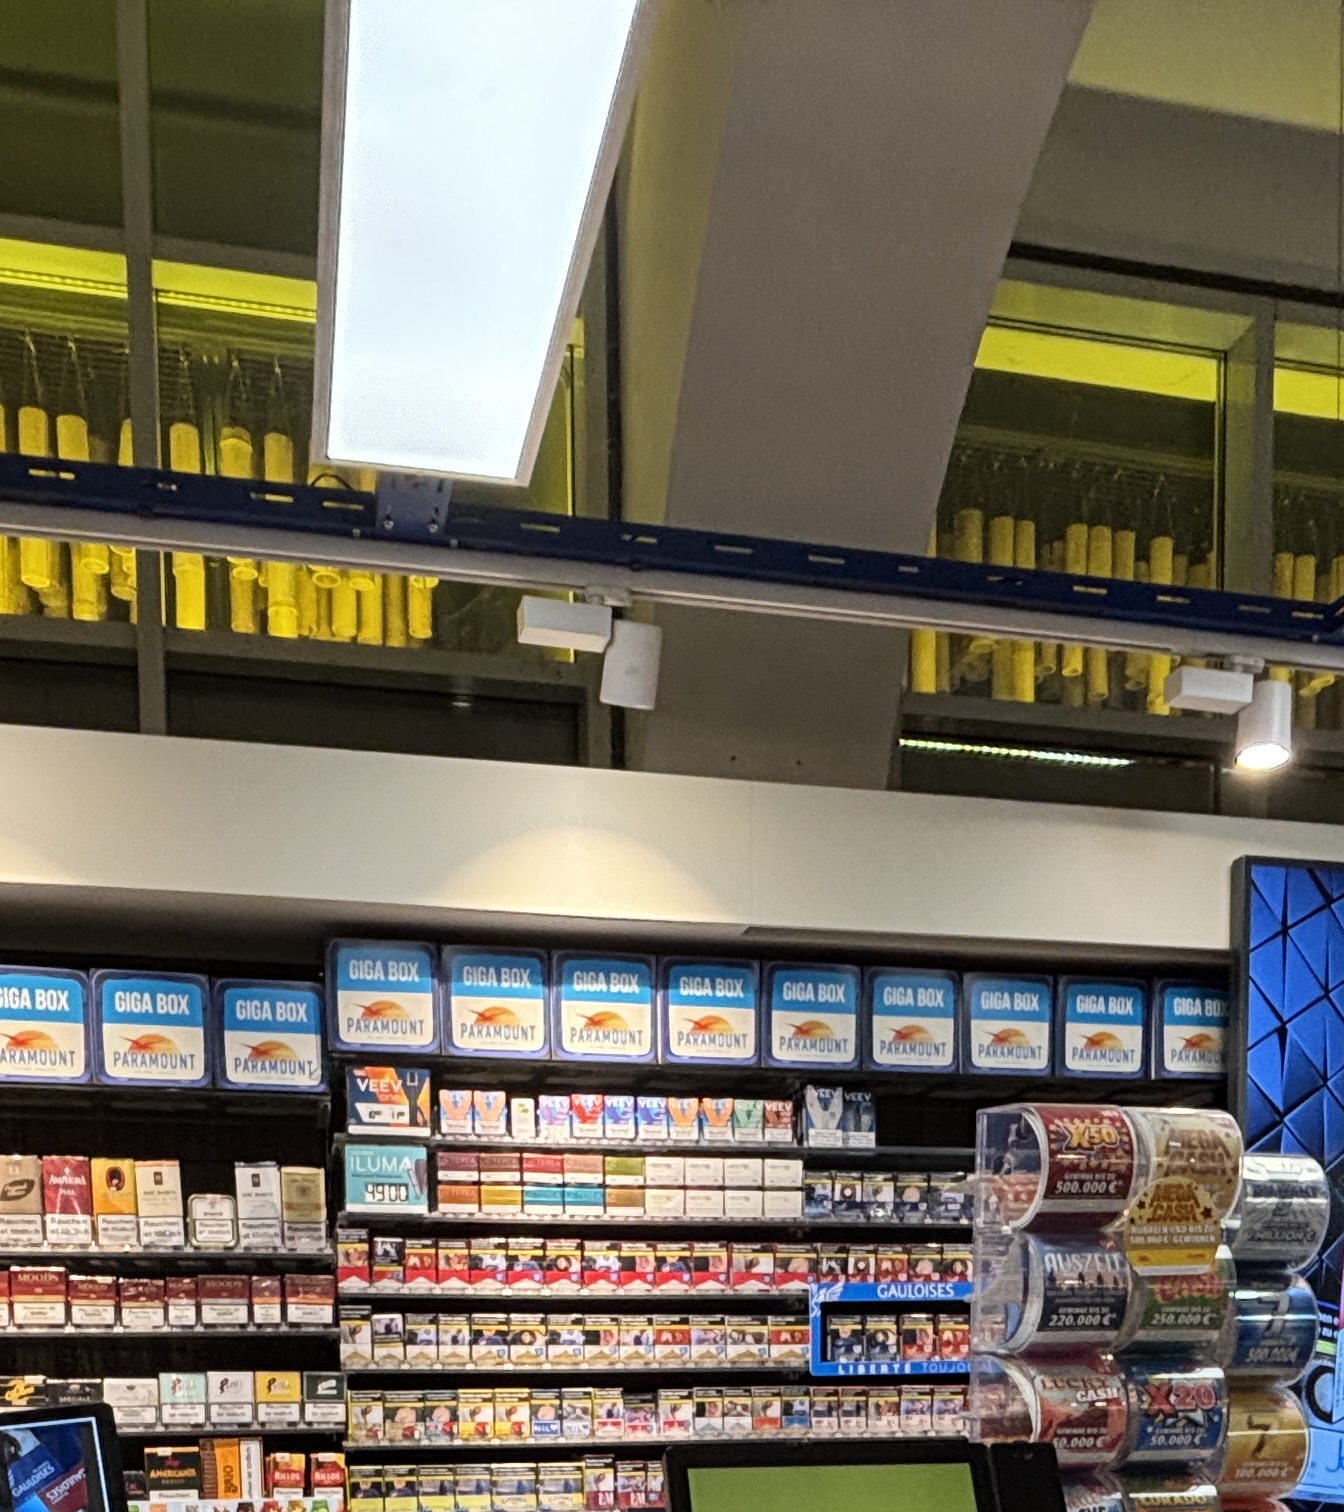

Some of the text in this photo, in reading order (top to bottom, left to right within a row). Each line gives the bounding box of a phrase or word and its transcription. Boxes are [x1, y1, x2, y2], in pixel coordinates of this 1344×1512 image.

[348, 960, 420, 983] GIGA BOX
[462, 965, 532, 990] GIGA BOX
[572, 970, 640, 994] GIGA BOX
[679, 976, 745, 999] GIGA BOX
[34, 989, 70, 1012] BOX
[782, 981, 846, 1004] GIGA BOX
[883, 986, 944, 1008] GIGA BOX
[980, 991, 1041, 1013] GIGA BOX
[114, 992, 190, 1016] GIGA BOX
[235, 999, 308, 1023] GIGA BOX
[1076, 995, 1134, 1016] GIGA BOX
[1173, 998, 1201, 1017] GIGA
[346, 1016, 425, 1036] PARAMOUNT
[460, 1022, 536, 1042] PARAMOUNT
[569, 1027, 644, 1047] PARAMOUNT
[676, 1031, 748, 1050] PARAMOUNT
[779, 1035, 849, 1054] PARAMOUNT
[879, 1040, 947, 1058] PARAMOUNT
[978, 1044, 1043, 1062] PARAMOUNT
[1071, 1046, 1135, 1064] PARAMOUNT
[113, 1050, 196, 1070] PARAMOUNT
[233, 1058, 315, 1077] PARAMOUNT
[356, 1077, 403, 1094] VEEV
[1067, 1121, 1121, 1150] X50
[350, 1156, 412, 1173] ILUMA
[1054, 1181, 1106, 1195] 500.000
[1043, 1250, 1123, 1273] AUSZEIT
[17, 1273, 59, 1283] MOODS
[876, 1283, 955, 1299] GAULOISES
[1048, 1314, 1100, 1327] 220.000
[1151, 1313, 1202, 1326] 250.000
[1040, 1375, 1108, 1390] LUCKY
[1075, 1386, 1120, 1403] CASH
[1145, 1383, 1217, 1415] X20
[1149, 1435, 1190, 1447] 50.000
[11, 1464, 56, 1498] GAULOISES
[149, 1467, 197, 1480] AMERICANOS
